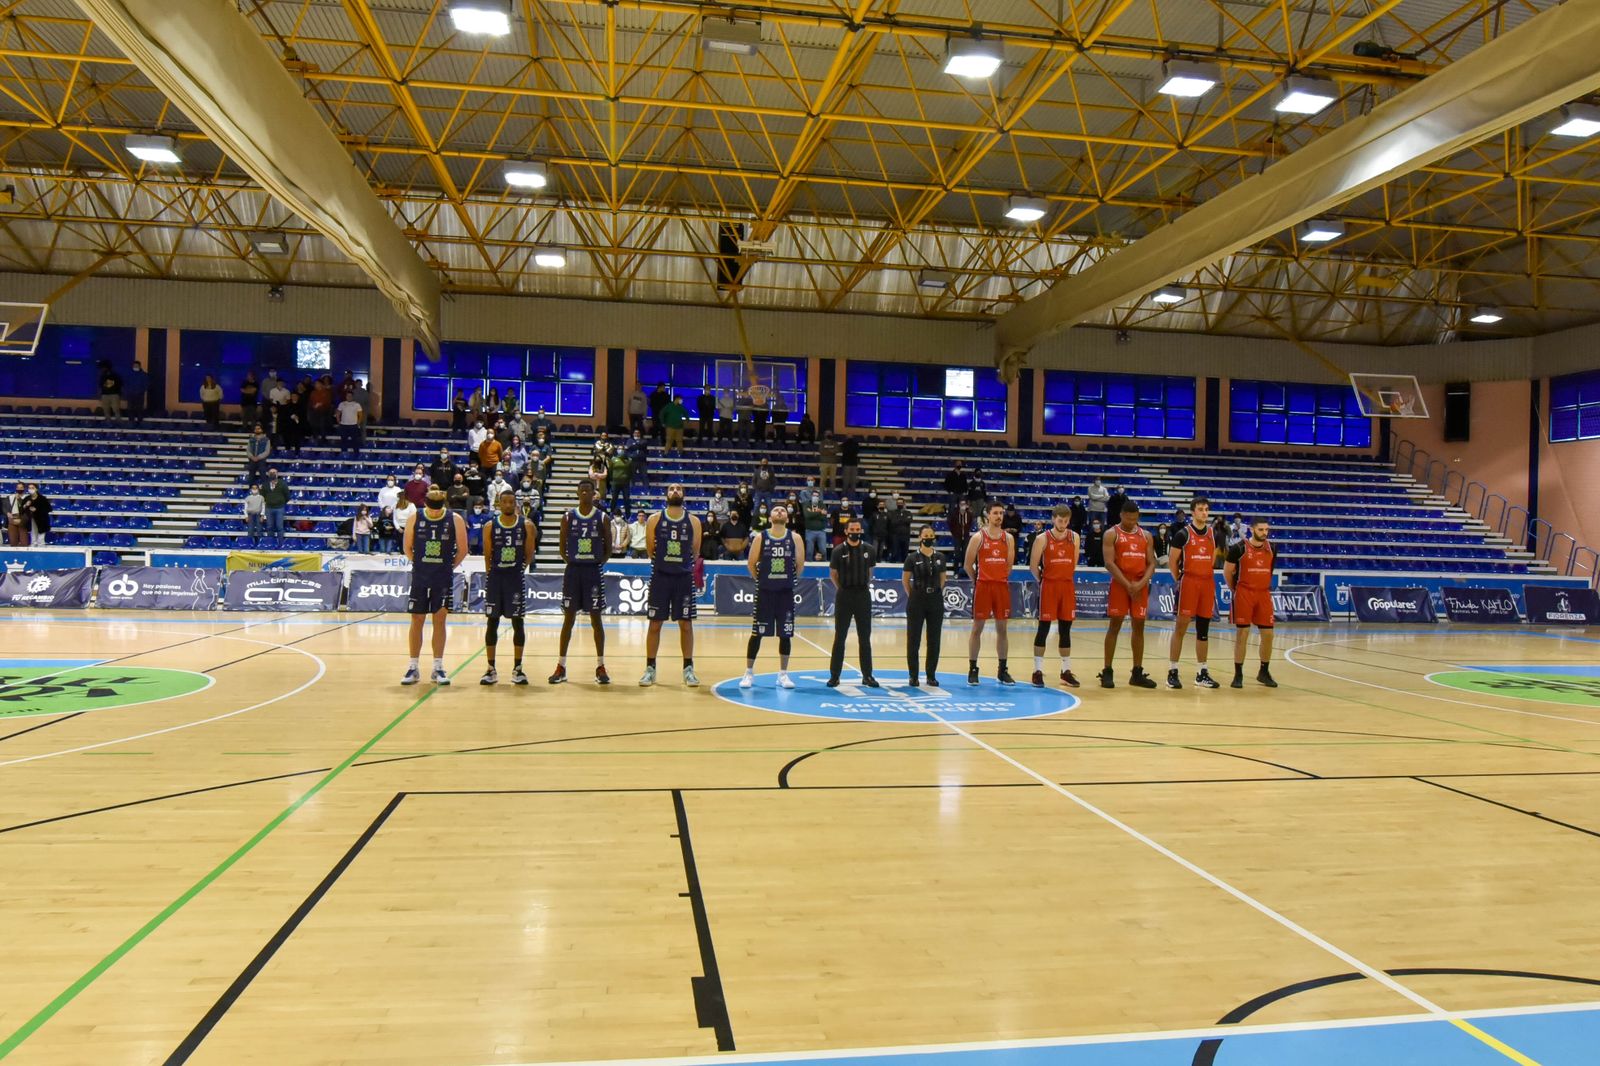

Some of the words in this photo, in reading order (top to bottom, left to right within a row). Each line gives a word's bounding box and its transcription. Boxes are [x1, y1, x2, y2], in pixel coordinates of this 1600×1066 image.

[431, 529, 436, 540] 1
[581, 527, 588, 537] 7
[670, 529, 677, 540] 8
[505, 535, 512, 546] 3
[771, 546, 784, 557] 30
[246, 577, 323, 589] multimarcas
[592, 598, 598, 606] 7
[1373, 599, 1416, 611] populares
[1445, 597, 1479, 610] Frida
[683, 607, 689, 615] 8
[783, 623, 793, 632] 30
